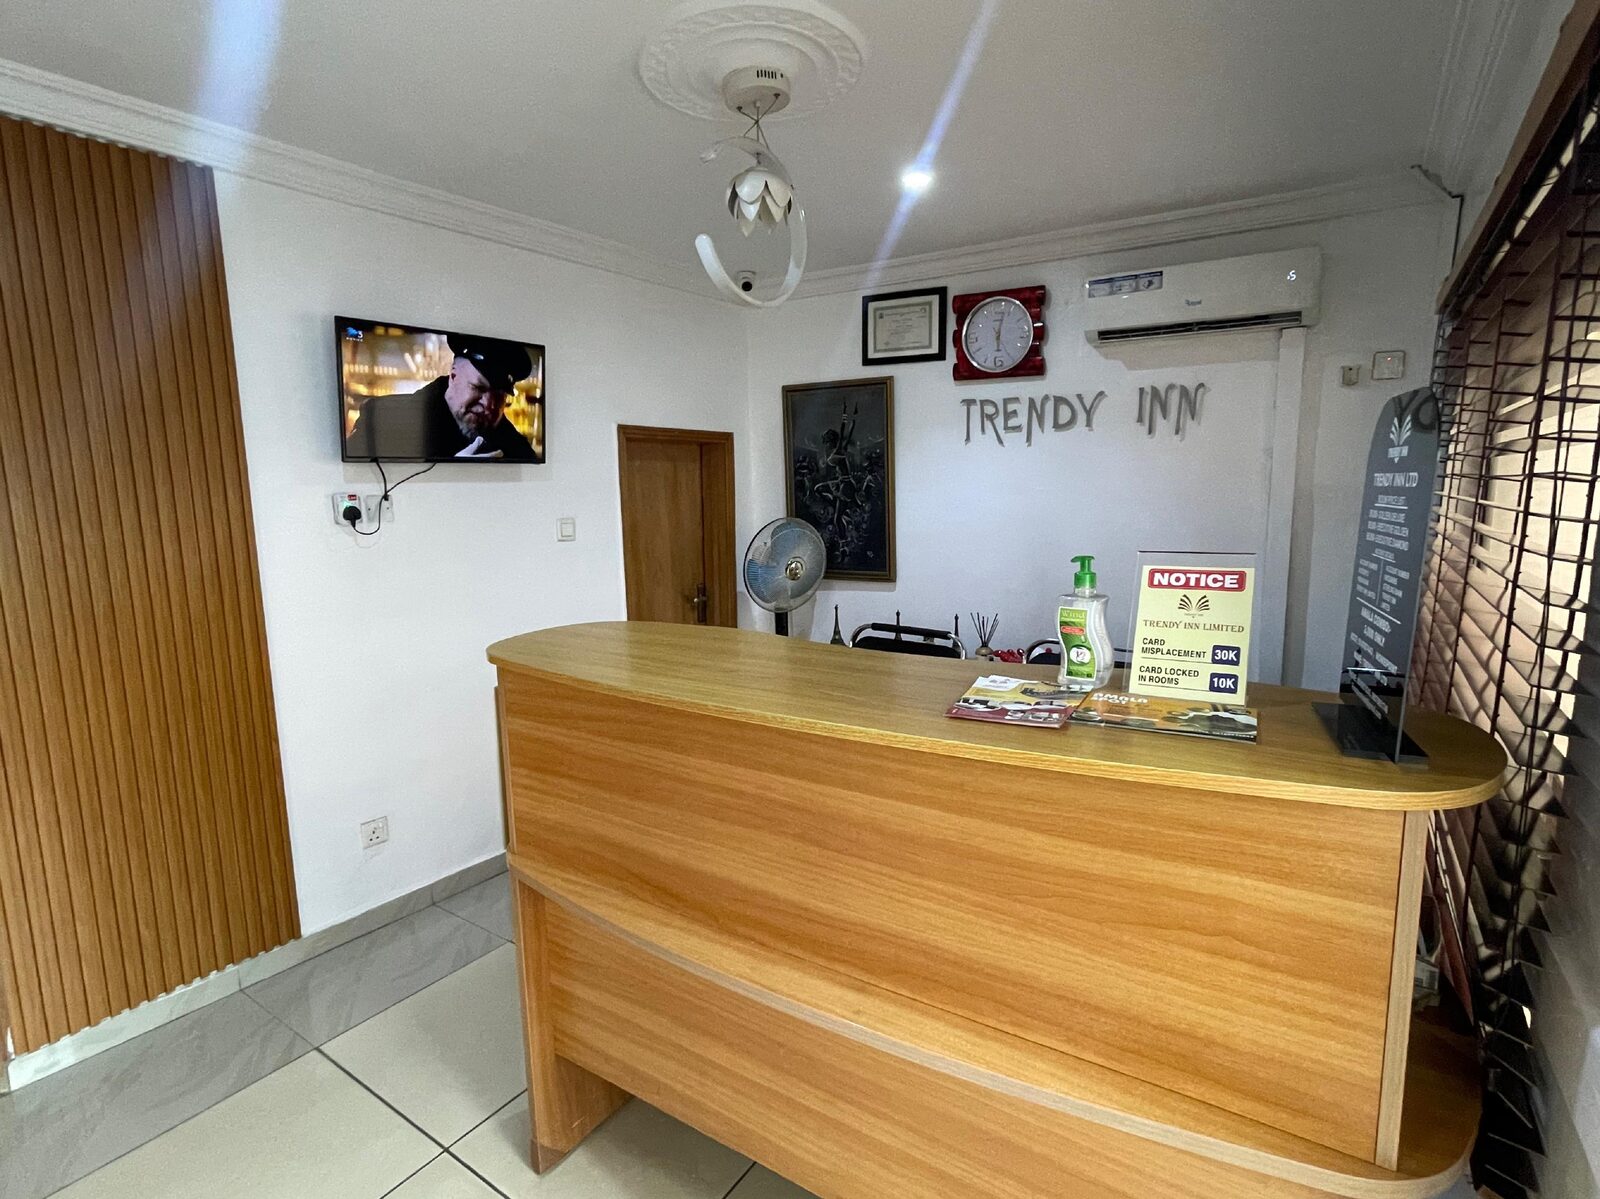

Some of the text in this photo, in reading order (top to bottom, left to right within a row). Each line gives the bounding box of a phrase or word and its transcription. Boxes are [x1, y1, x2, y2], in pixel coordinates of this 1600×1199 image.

[960, 383, 1210, 447] TRENDY INN
[1405, 471, 1419, 488] LTD
[1152, 572, 1240, 589] NOTICE
[1143, 619, 1245, 633] TRENDY INN LIMITED
[1142, 637, 1166, 646] CARD
[1141, 646, 1237, 662] MISPLACEMENT 30K
[1139, 665, 1200, 678] CARD LOCKED
[1138, 674, 1235, 689] IN ROOMS 10K
